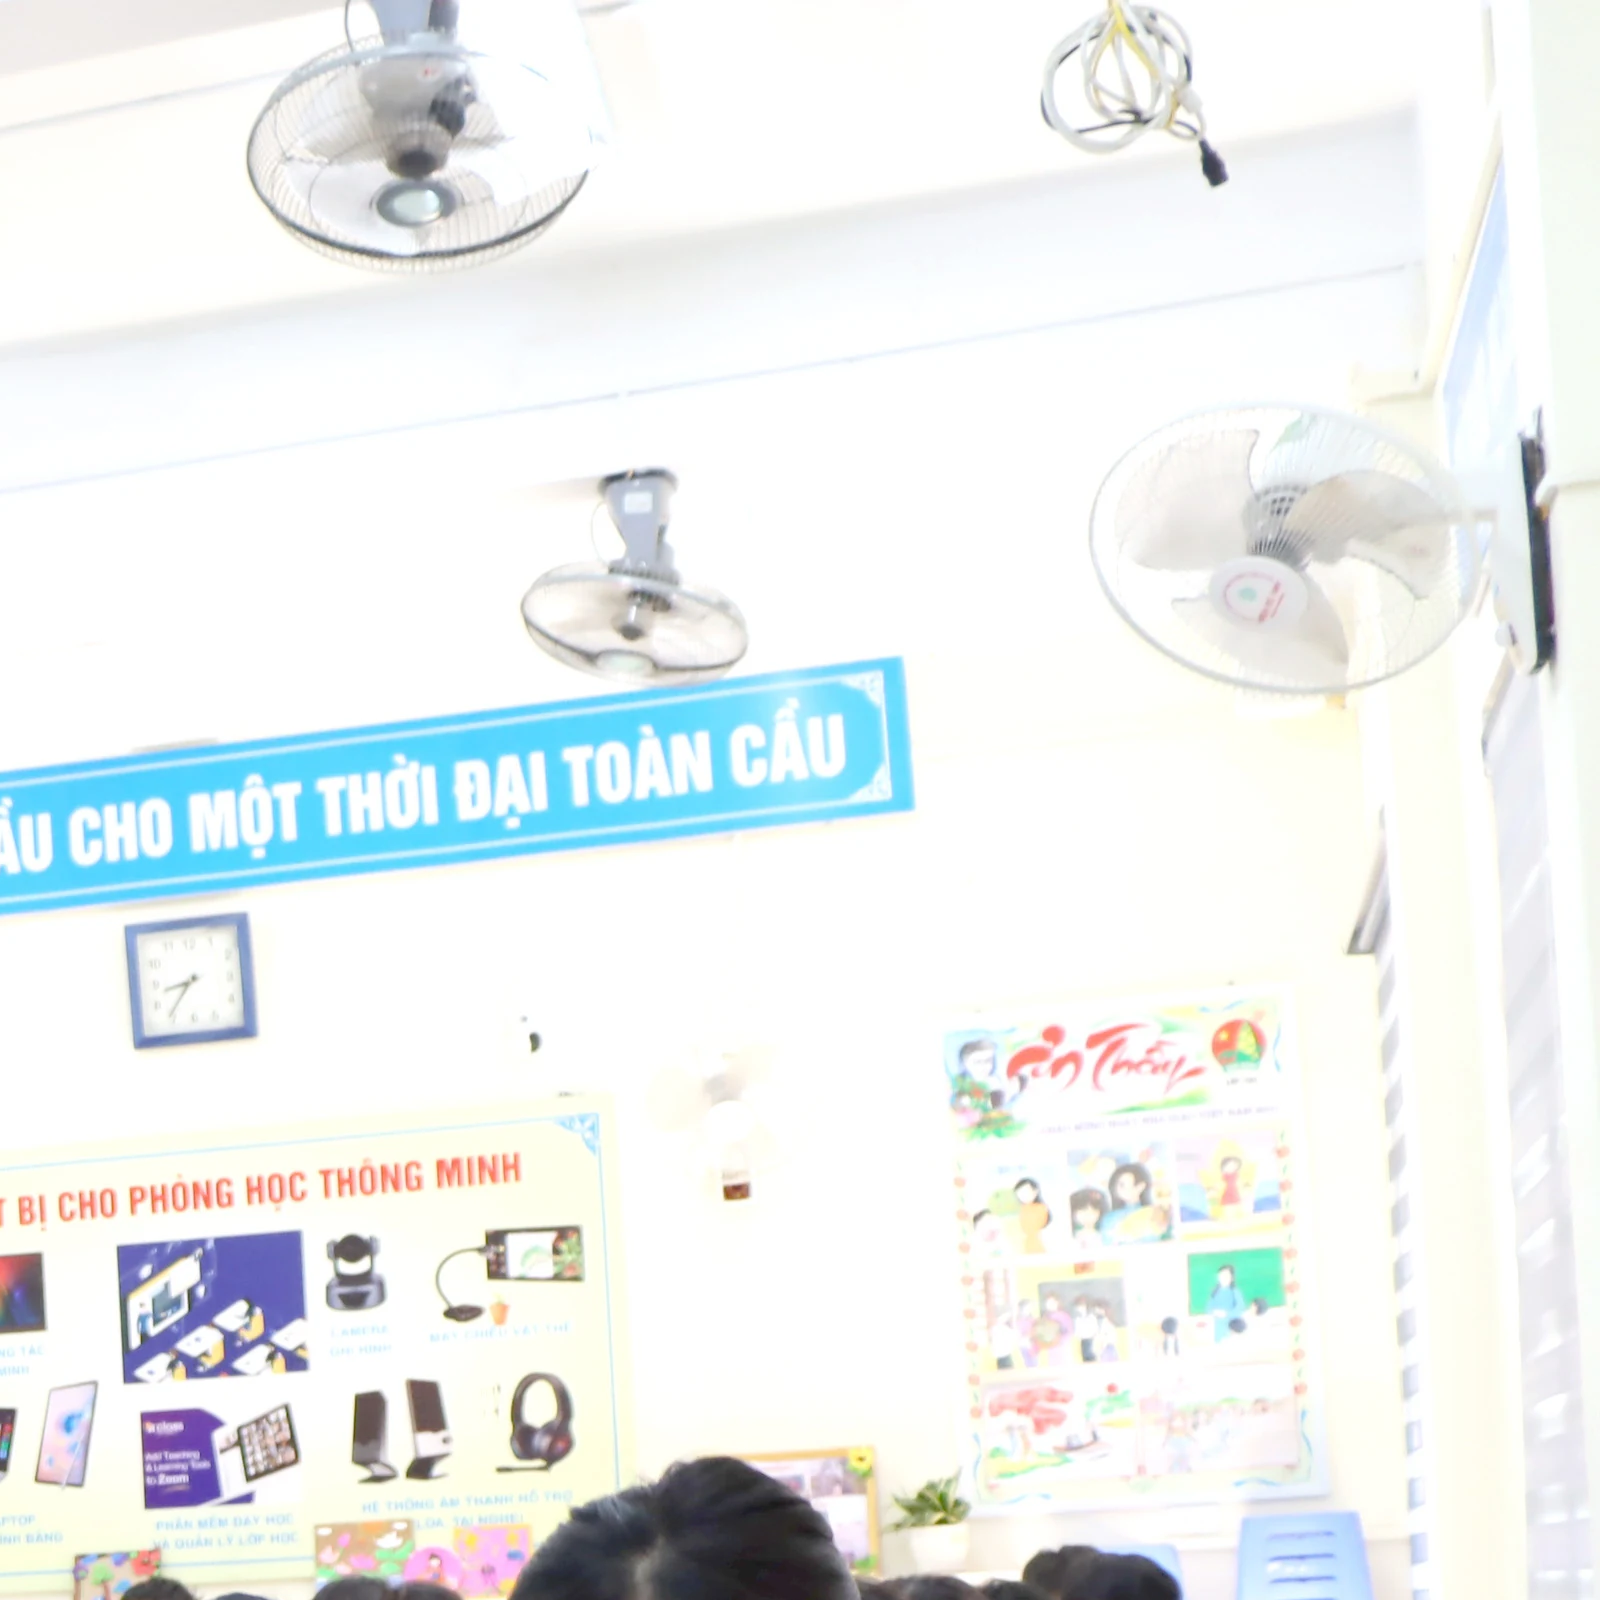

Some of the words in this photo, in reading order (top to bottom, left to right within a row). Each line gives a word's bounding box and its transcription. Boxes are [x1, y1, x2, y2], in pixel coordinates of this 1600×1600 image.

[67, 812, 174, 862] CHO
[188, 773, 302, 860] MỘT
[314, 752, 440, 838] THỜI
[452, 750, 549, 832] ĐẠI
[561, 722, 715, 809] TOÀN
[728, 696, 848, 785] CẦU
[17, 1193, 48, 1236] BỊ
[58, 1185, 118, 1222] CHO
[129, 1173, 234, 1217] PHÒNG
[246, 1171, 308, 1213] HỌC
[319, 1154, 425, 1199] THÔNG
[435, 1152, 522, 1188] MINH
[158, 1473, 190, 1485] Zoom
